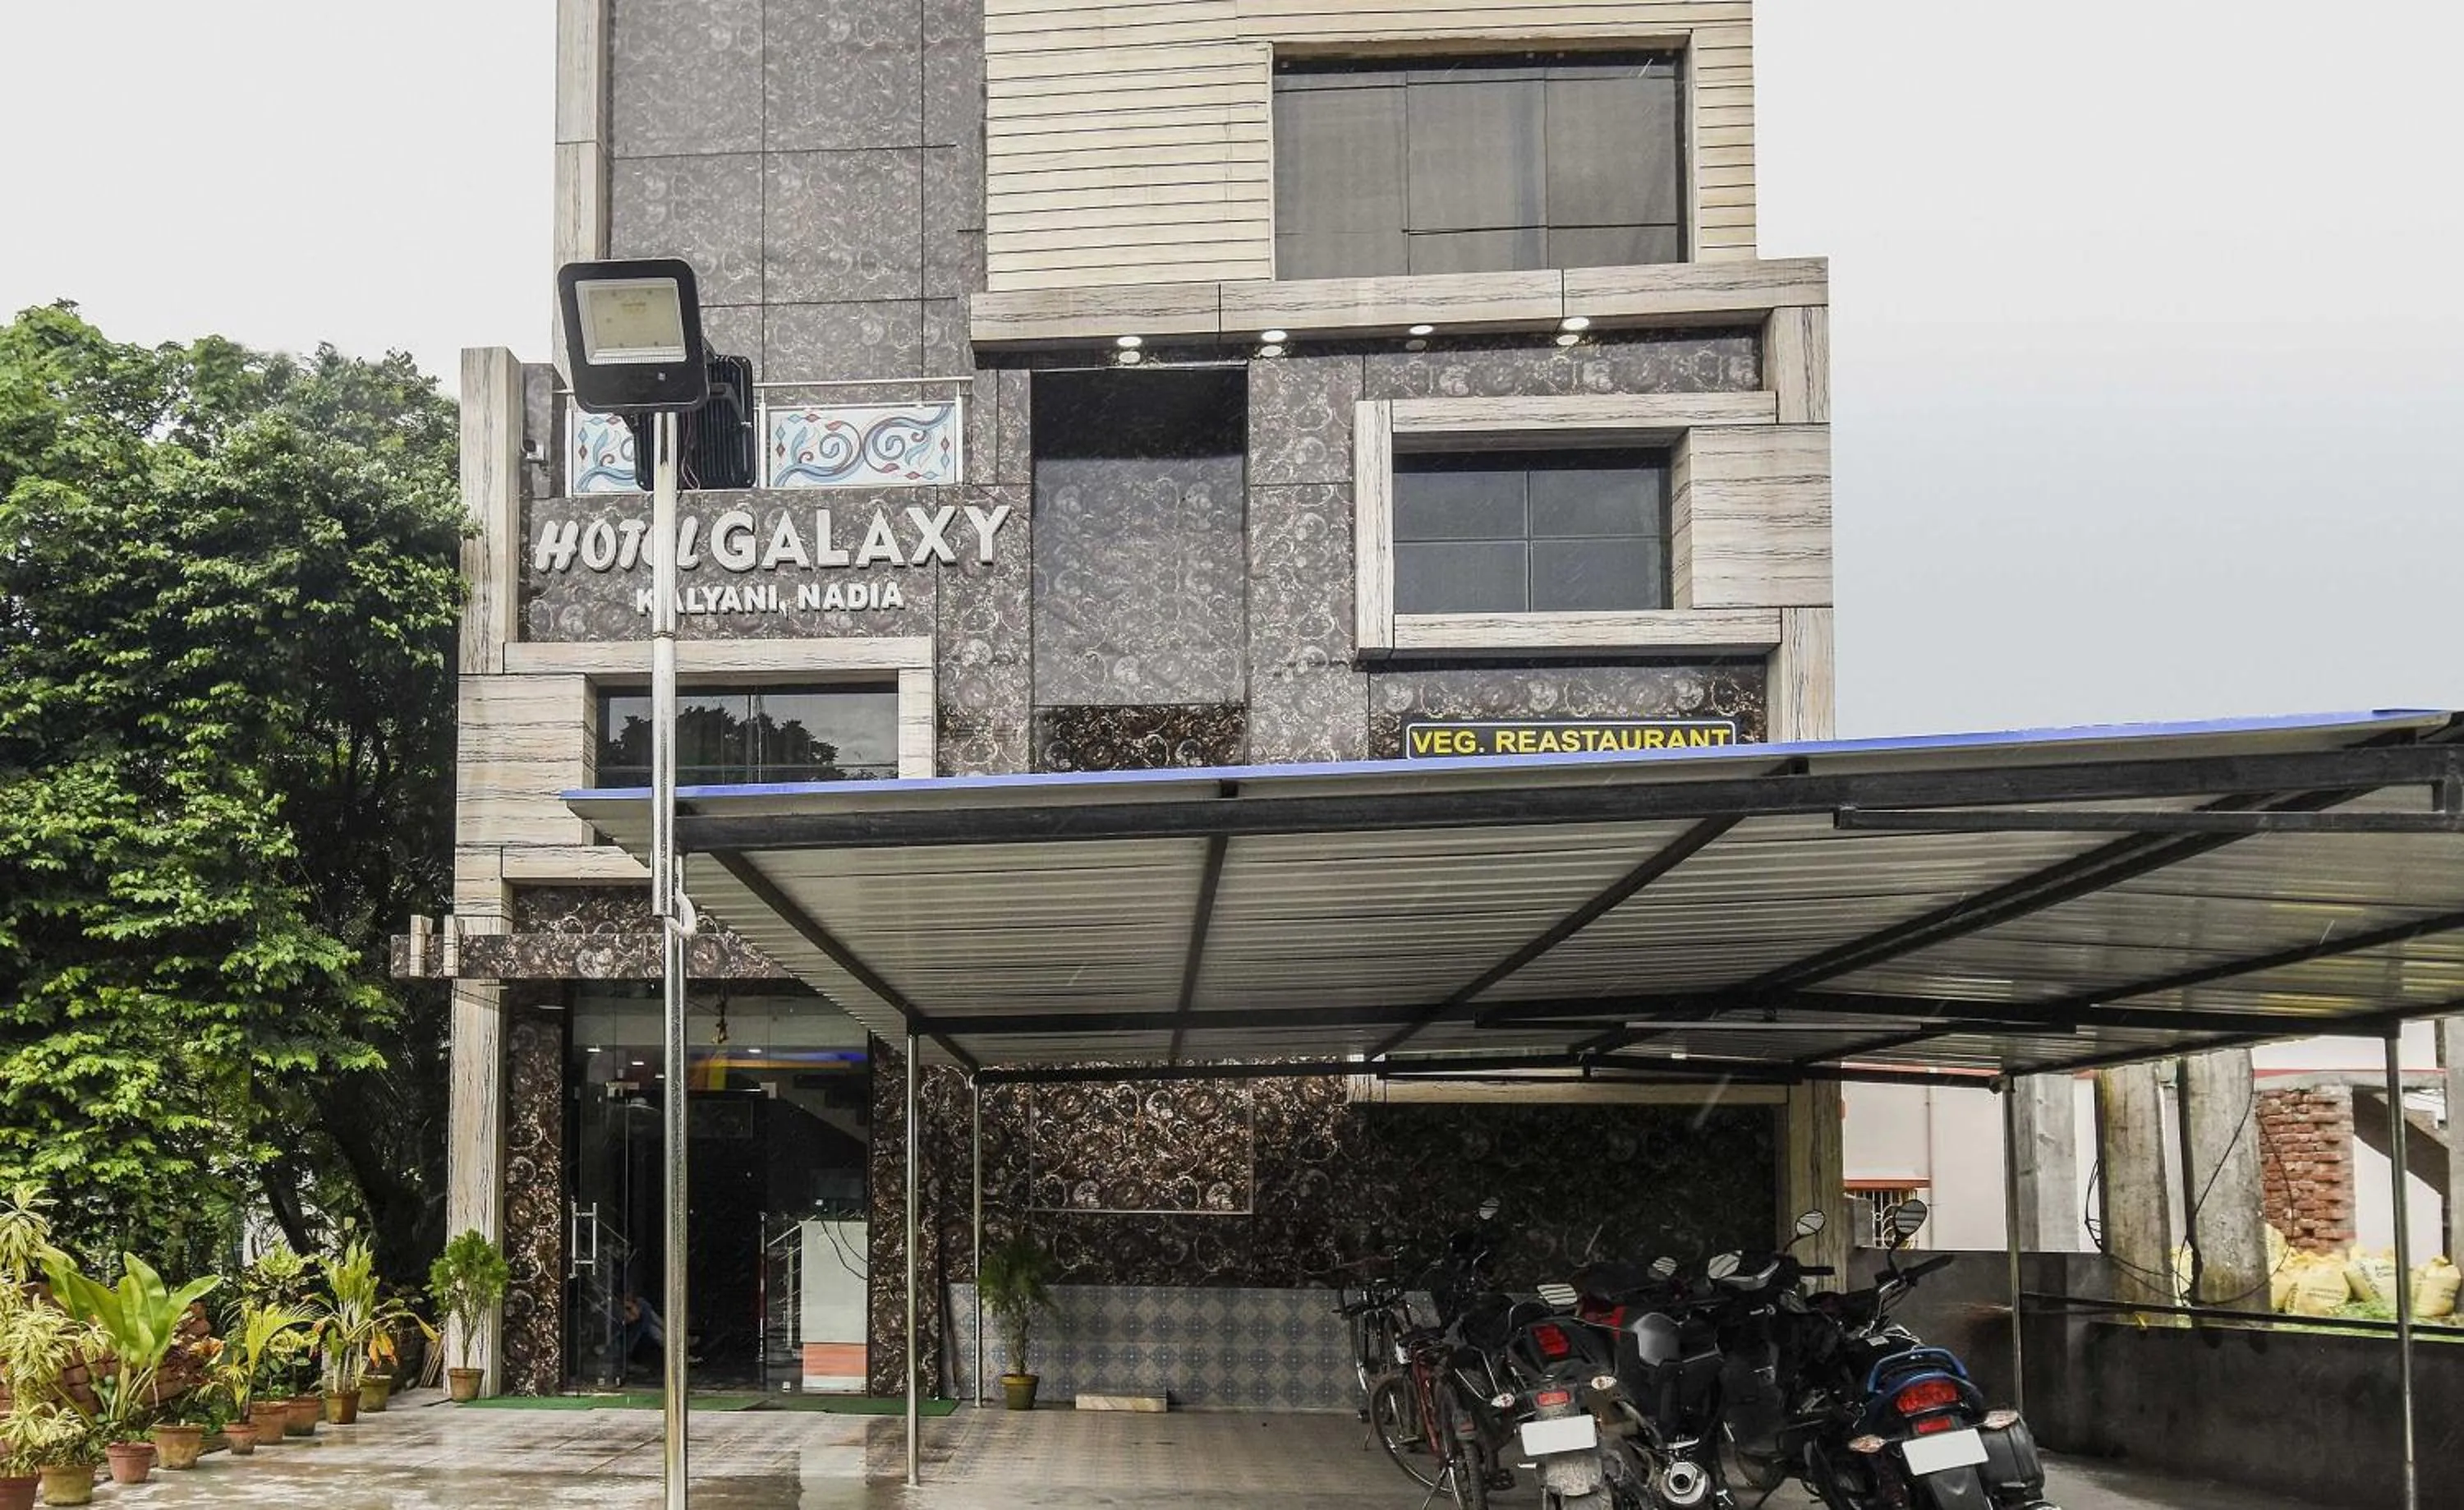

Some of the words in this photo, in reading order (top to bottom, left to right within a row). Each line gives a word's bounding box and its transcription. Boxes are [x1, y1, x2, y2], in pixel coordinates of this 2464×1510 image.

[711, 505, 1010, 571] GALAXY
[798, 581, 904, 611] NADIA
[1412, 730, 1485, 753] VEG.
[1496, 729, 1731, 753] REASTAURANT
